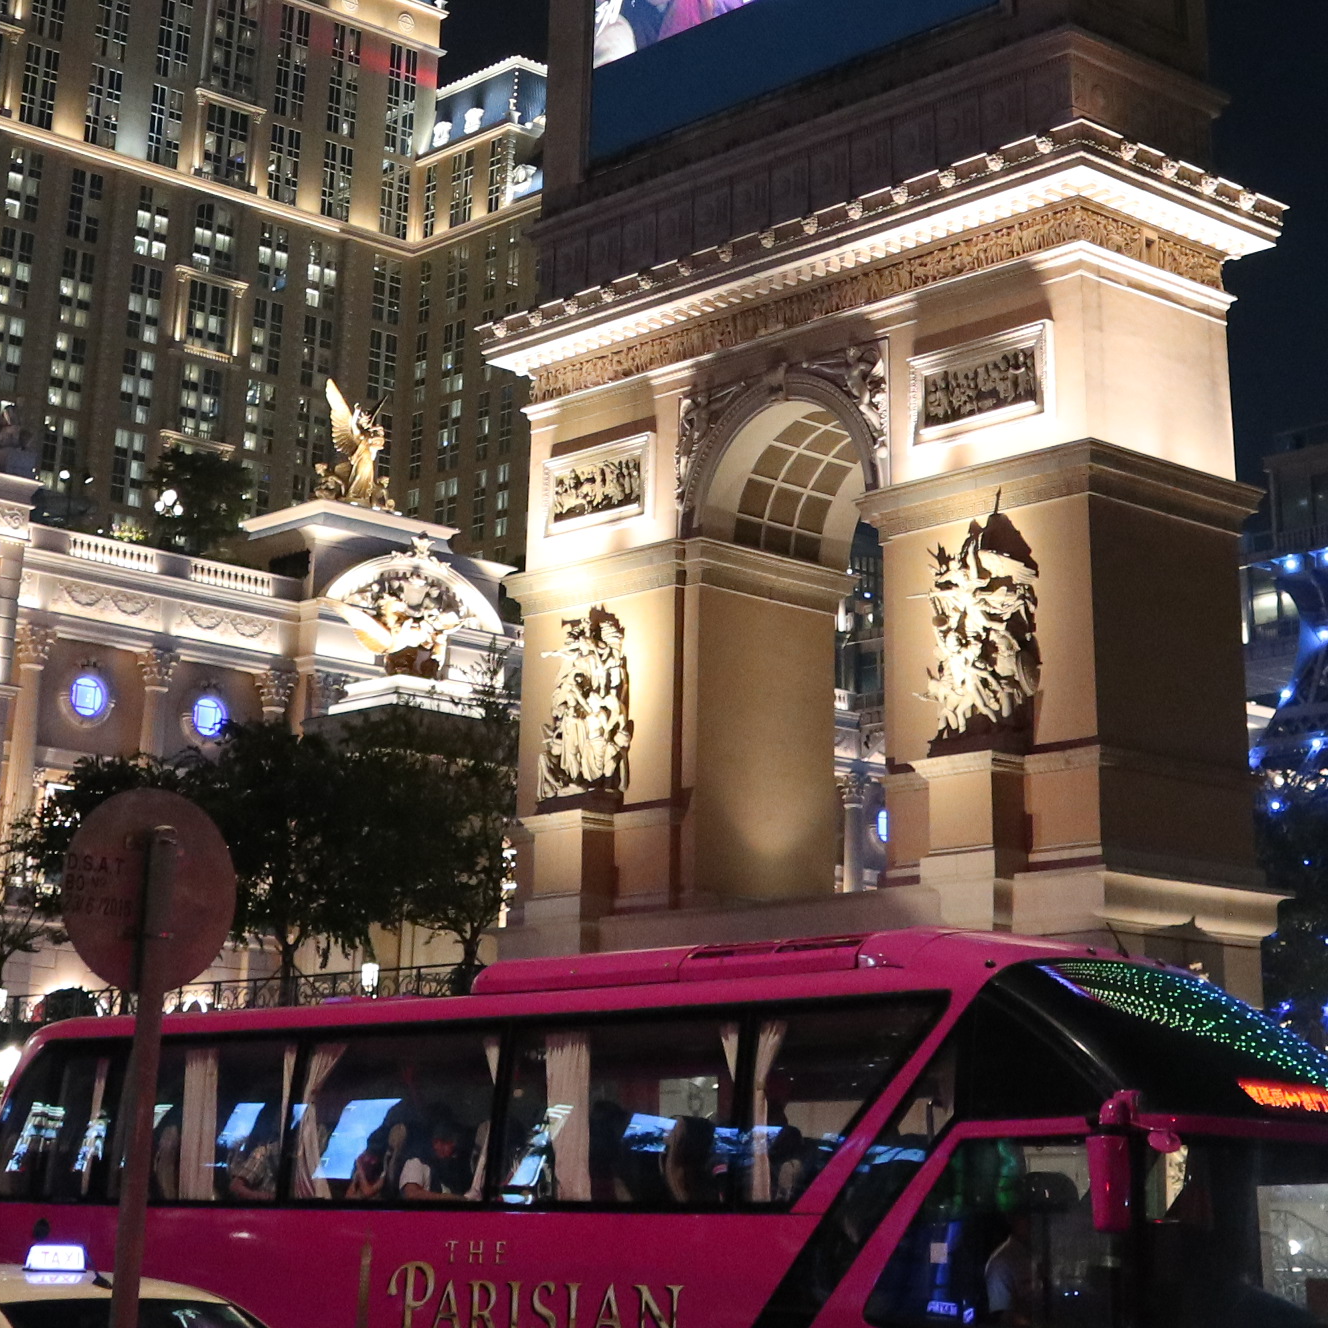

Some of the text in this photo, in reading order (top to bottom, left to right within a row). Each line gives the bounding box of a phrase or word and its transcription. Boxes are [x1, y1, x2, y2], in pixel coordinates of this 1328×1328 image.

[41, 1251, 80, 1265] TAXI
[445, 1239, 507, 1264] THE
[387, 1260, 685, 1328] PARISIAN
